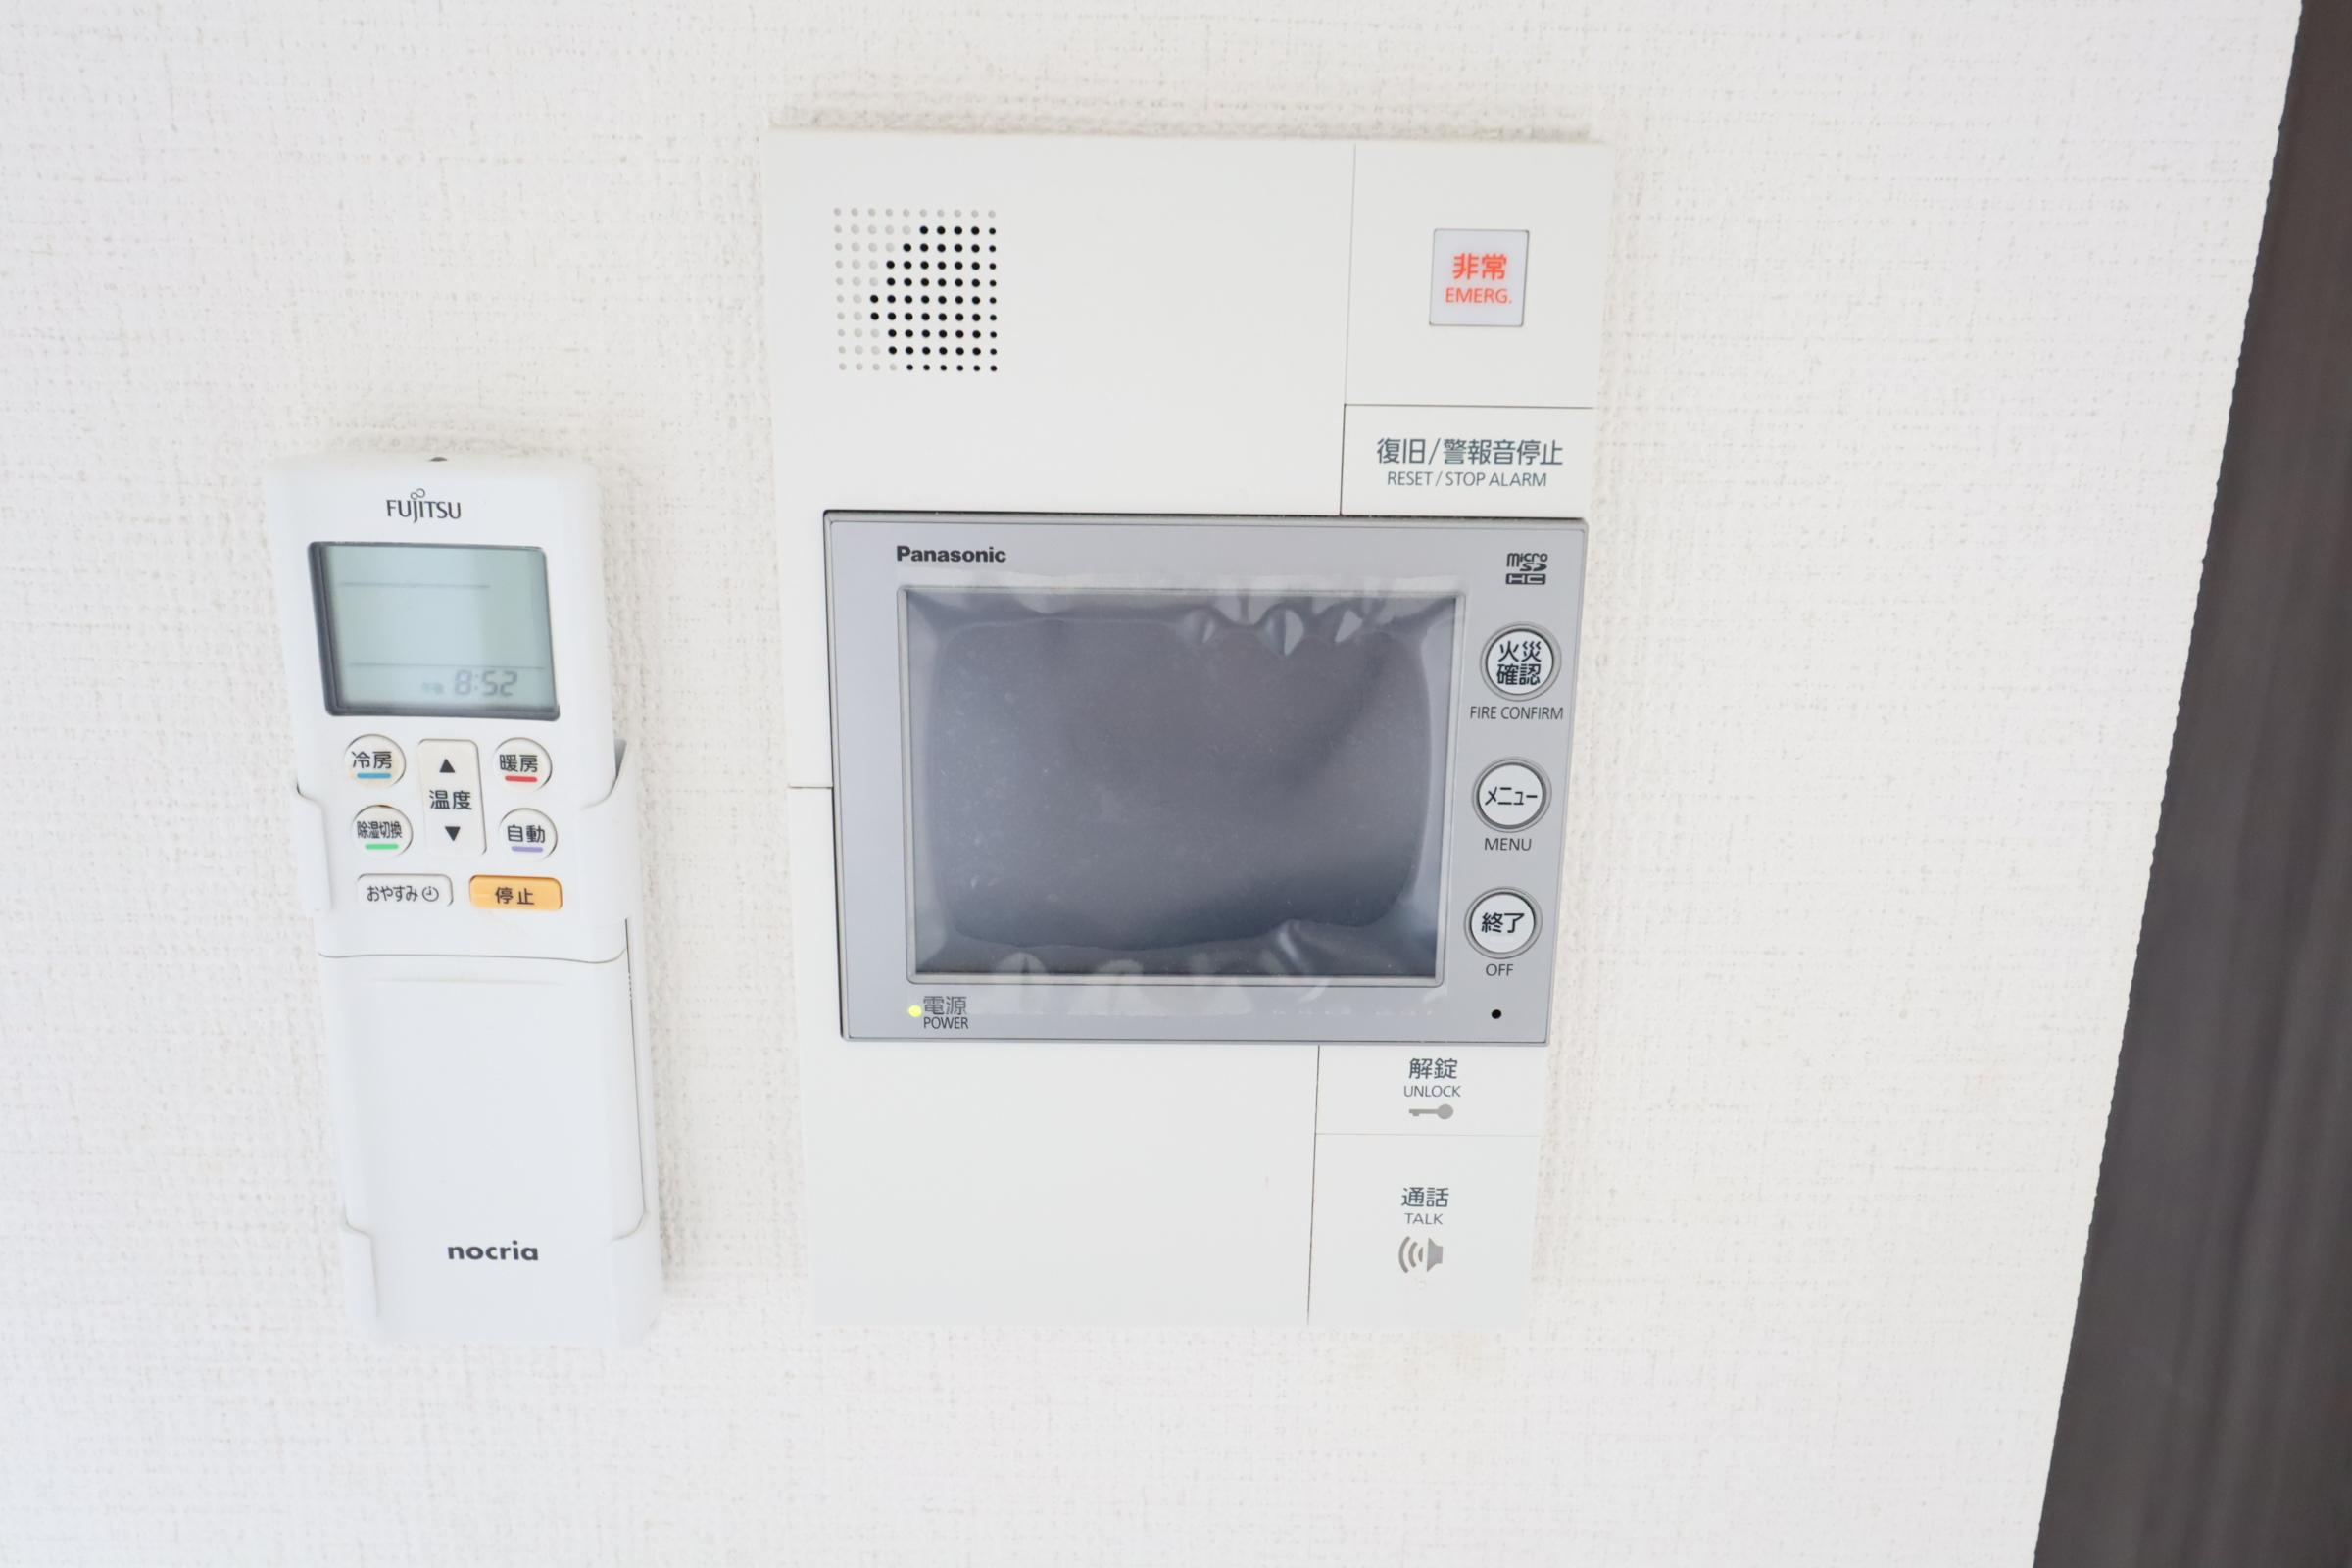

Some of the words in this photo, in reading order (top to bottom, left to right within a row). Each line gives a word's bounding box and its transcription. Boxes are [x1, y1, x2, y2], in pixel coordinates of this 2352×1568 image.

[1453, 253, 1507, 280] 非常
[1445, 287, 1512, 304] EMERG.
[1489, 472, 1547, 487] ALARM
[386, 489, 462, 523] FUJITSU
[896, 545, 1006, 563] Panasonic
[1498, 640, 1542, 662] 火災
[454, 669, 518, 696] 8:52
[1496, 663, 1542, 685] 確認
[1470, 706, 1497, 720] FIRE
[1500, 706, 1564, 720] CONFIRM
[352, 751, 392, 770] 冷房
[499, 754, 538, 773] 暖房
[428, 790, 472, 810] 温度
[1485, 786, 1538, 806] メニュー
[357, 821, 403, 839] 除湿切換
[507, 824, 546, 844] 自動
[1484, 838, 1533, 851] MENU
[367, 885, 418, 903] おやすみ
[495, 888, 535, 906] 停止
[1481, 912, 1525, 933] 終了
[1486, 963, 1514, 977] OFF
[923, 995, 967, 1015] 電源
[923, 1016, 969, 1029] POWER
[1408, 1057, 1458, 1079] 解錠
[1403, 1085, 1461, 1098] UNLOCK
[1400, 1187, 1449, 1207] 通話
[1404, 1213, 1444, 1225] TALK
[448, 1240, 539, 1261] nocria
